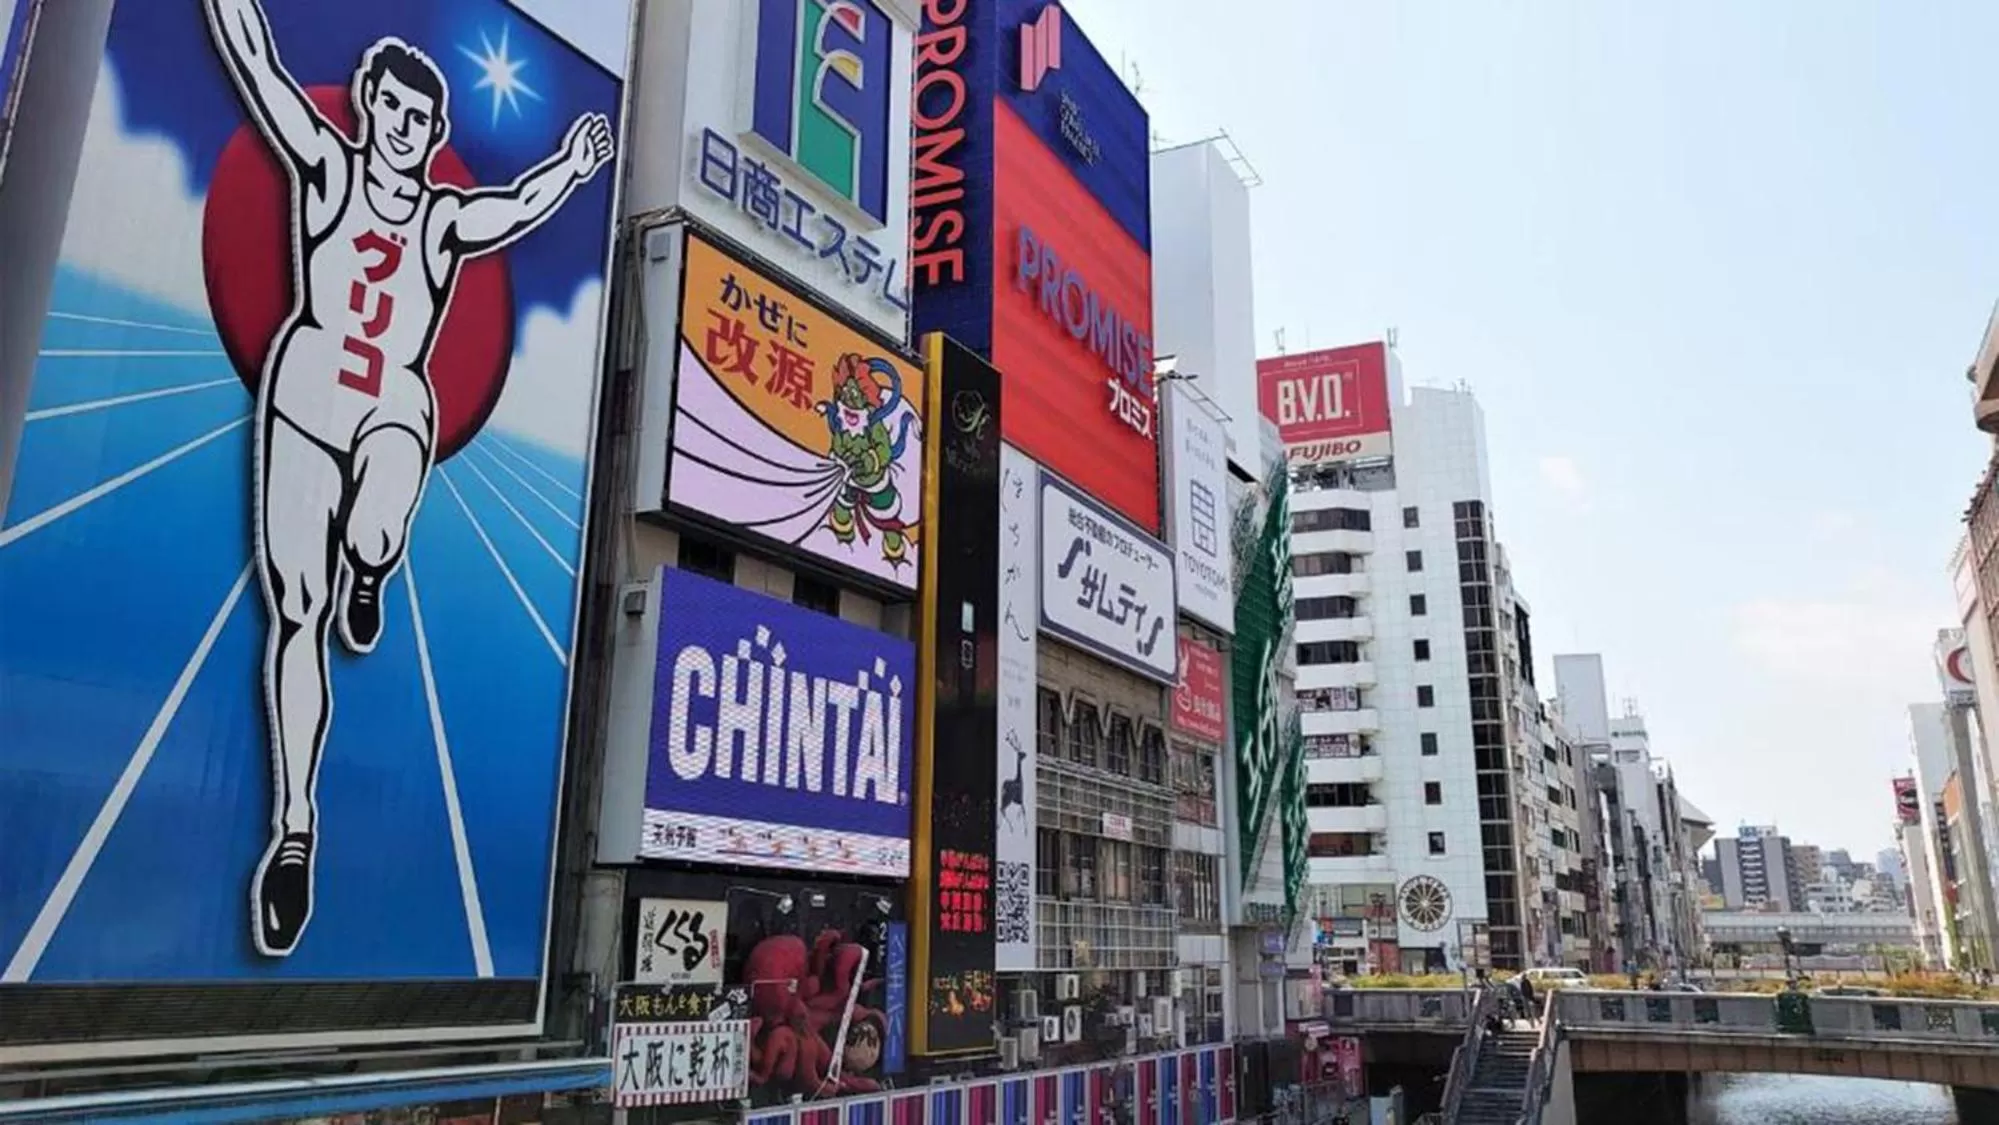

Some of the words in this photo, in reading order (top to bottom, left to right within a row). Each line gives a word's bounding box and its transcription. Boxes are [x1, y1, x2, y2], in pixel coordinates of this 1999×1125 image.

[338, 229, 408, 398] グリコ
[719, 272, 808, 348] かぜに
[1017, 222, 1151, 398] PROMISE
[706, 307, 816, 411] 改源
[1108, 377, 1152, 439] プロミス
[1277, 372, 1352, 425] B.V.D.
[1288, 440, 1362, 462] FUJIBO
[1077, 563, 1148, 633] サムティ
[668, 624, 902, 805] CHINTAI
[619, 1035, 730, 1091] 大阪に乾杯
